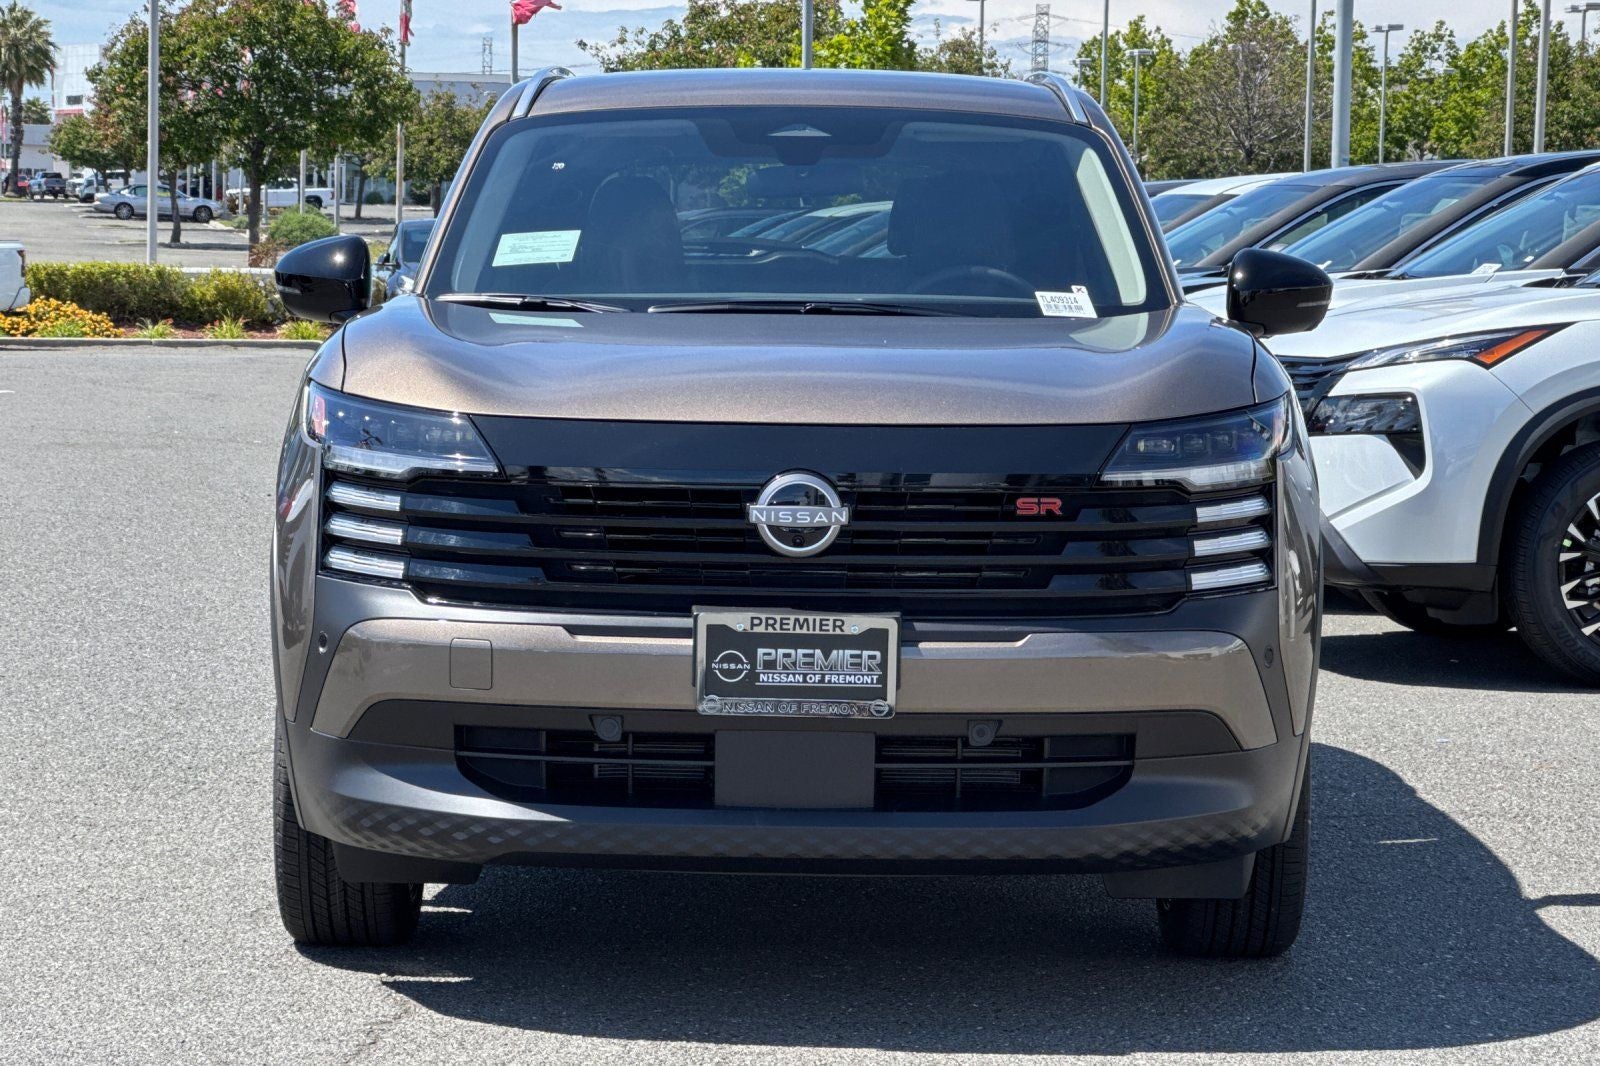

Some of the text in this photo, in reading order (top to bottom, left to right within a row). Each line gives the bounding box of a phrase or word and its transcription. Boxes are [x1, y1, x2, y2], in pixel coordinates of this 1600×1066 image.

[1016, 497, 1063, 515] SR
[752, 509, 846, 524] NISSAN
[750, 616, 846, 633] PREMIER
[712, 662, 751, 670] NISSAN
[756, 648, 882, 672] PREMIER
[759, 673, 879, 685] NISSAN OF FREMONT
[722, 702, 775, 714] NISSAN
[777, 702, 798, 714] OF
[800, 704, 870, 716] FREMONT
